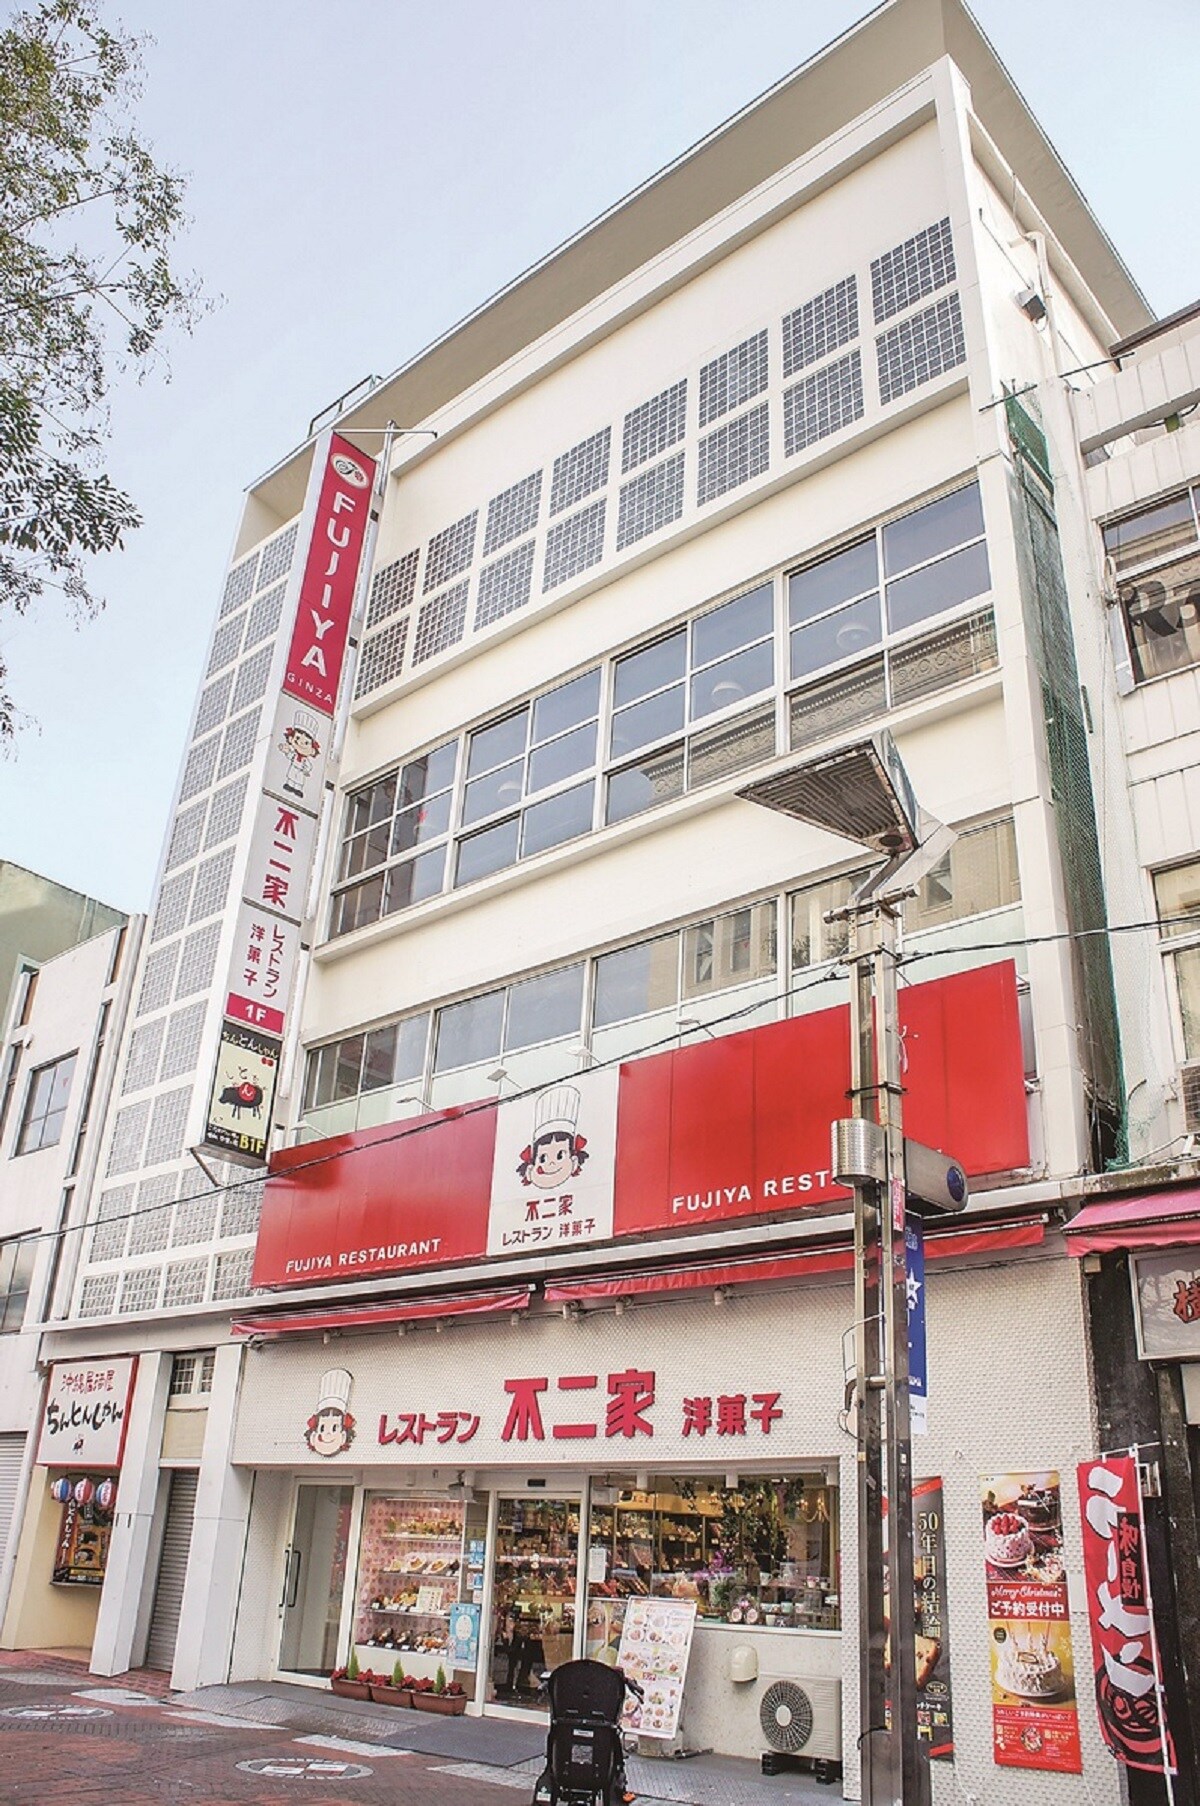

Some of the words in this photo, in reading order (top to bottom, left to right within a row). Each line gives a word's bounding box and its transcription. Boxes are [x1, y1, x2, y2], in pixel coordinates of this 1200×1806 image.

[301, 491, 356, 677] FUJIYA
[287, 672, 334, 704] GINZA
[262, 806, 299, 909] 不二家
[243, 923, 265, 987] 洋菓子
[263, 924, 285, 998] レストラン
[245, 1004, 266, 1022] 1F
[239, 1134, 265, 1154] B1F
[525, 1194, 573, 1221] 不二家
[672, 1184, 752, 1214] FUJIYA
[763, 1169, 835, 1197] REST
[502, 1226, 553, 1246] レストラン
[558, 1218, 596, 1239] 洋菓子
[285, 1254, 332, 1274] FUJIYA
[338, 1238, 442, 1266] RESTAURANT
[47, 1398, 124, 1435] ちんとんしゃん
[377, 1411, 481, 1446] レストラン
[500, 1368, 656, 1442] 不二家
[681, 1393, 784, 1437] 洋菓子
[918, 1511, 942, 1639] 50年目の結論
[991, 1600, 1065, 1617] ご予約受付中
